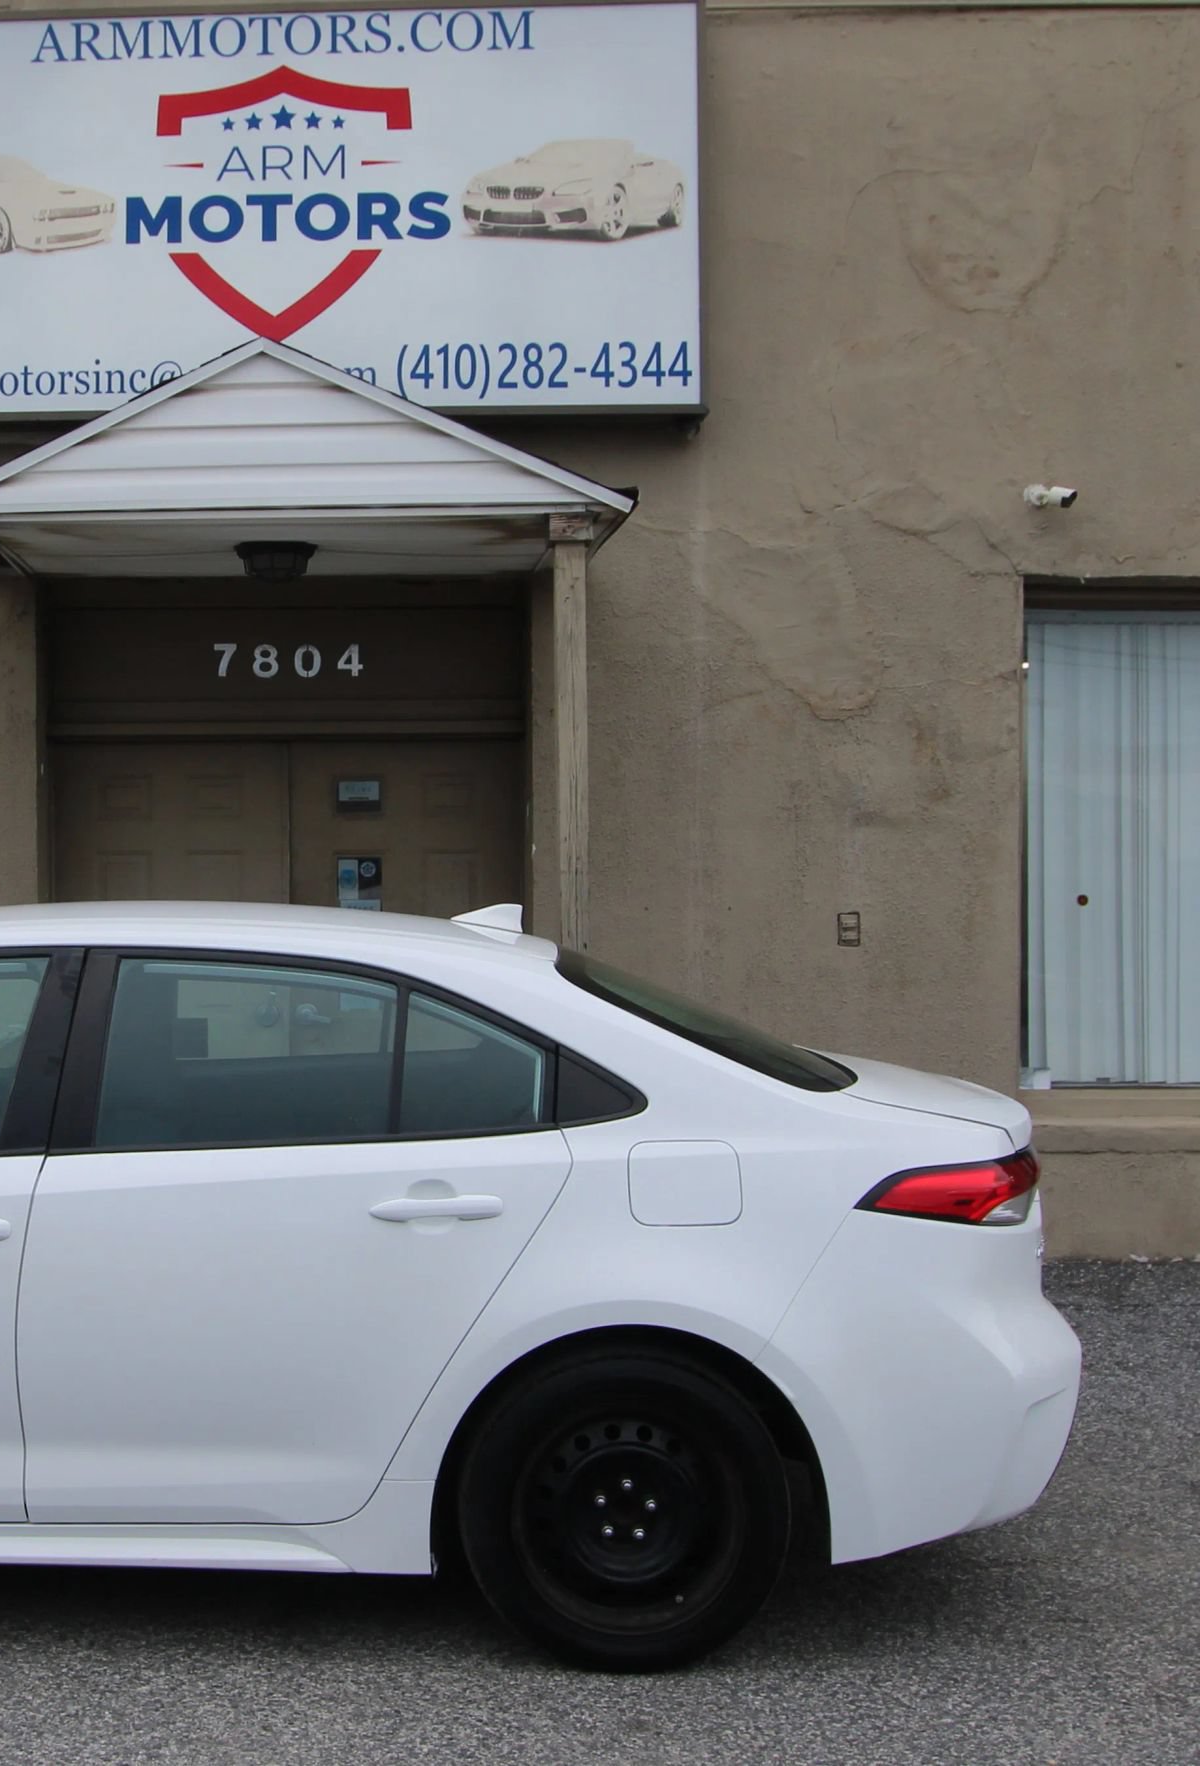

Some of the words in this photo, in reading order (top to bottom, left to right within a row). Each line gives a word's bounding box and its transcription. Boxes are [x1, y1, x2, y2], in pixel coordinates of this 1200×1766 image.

[32, 8, 535, 63] ARMMOTORS.COM
[217, 143, 347, 182] ARM
[124, 189, 453, 246] MOTORS
[395, 340, 694, 400] (410)282-4344
[213, 643, 364, 678] 7804
